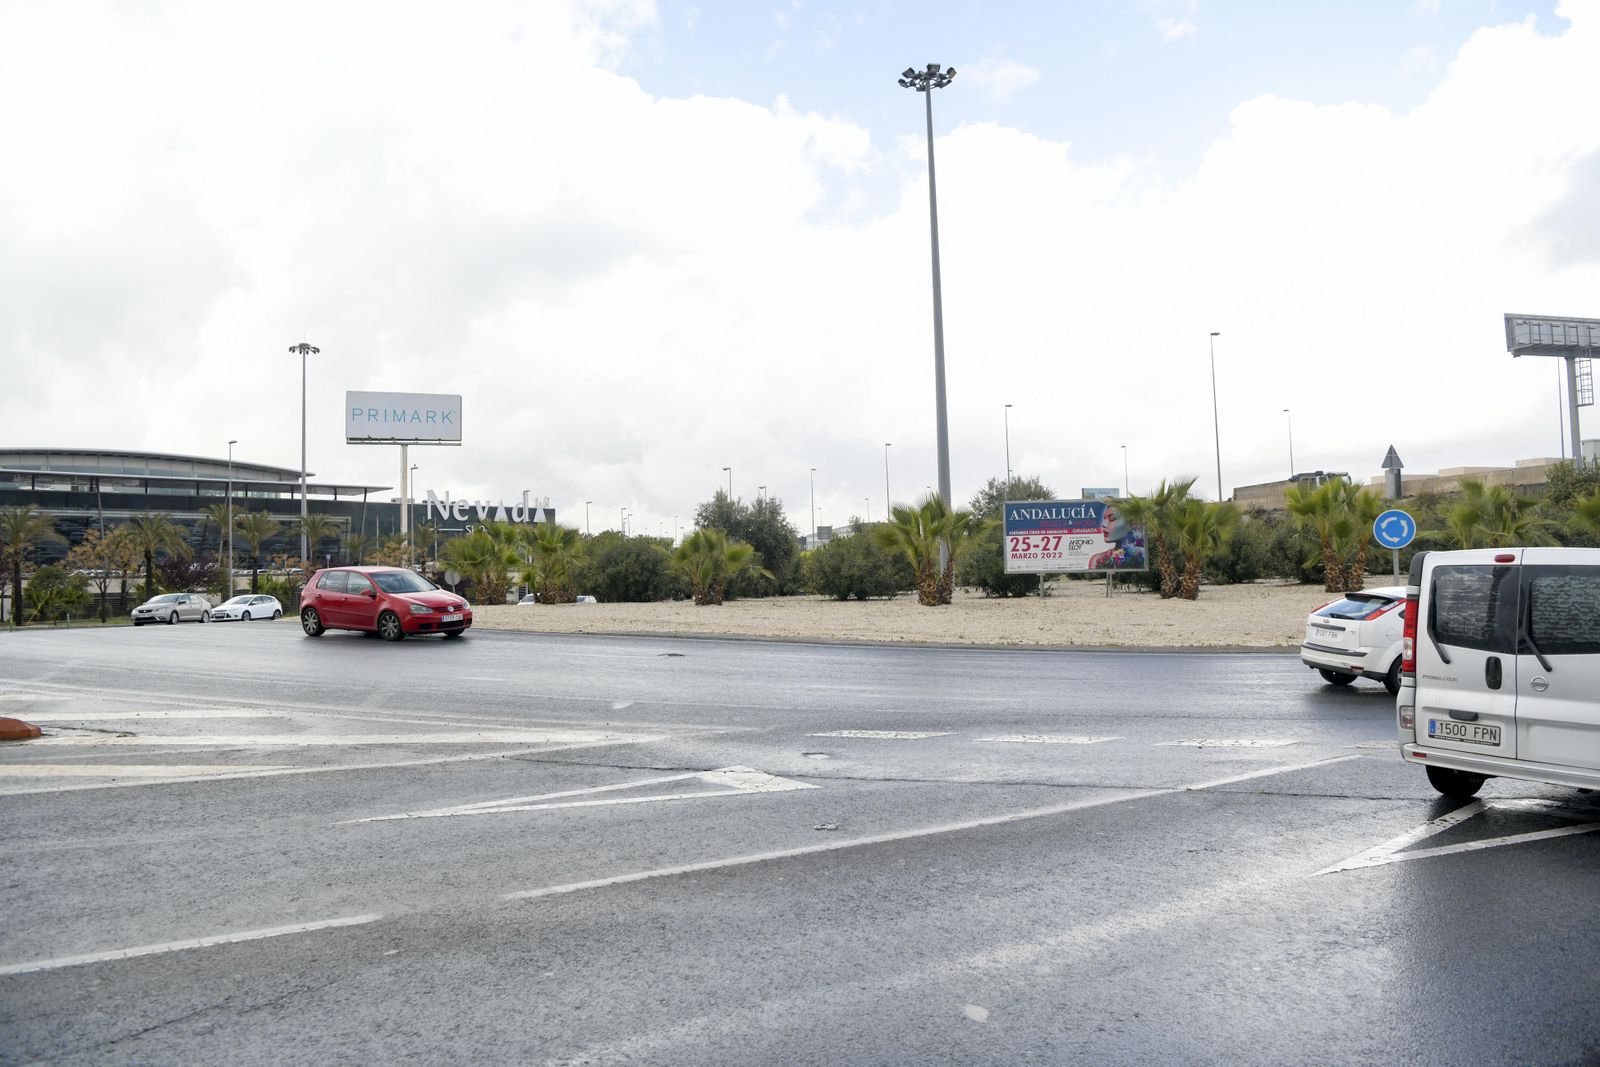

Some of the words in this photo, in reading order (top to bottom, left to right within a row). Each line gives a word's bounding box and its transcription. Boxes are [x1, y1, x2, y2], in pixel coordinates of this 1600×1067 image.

[351, 407, 453, 424] PRIMARK
[1009, 505, 1096, 520] ANDALUCÍA
[1010, 536, 1062, 552] 25-27
[1041, 551, 1062, 559] 2022
[1438, 722, 1467, 737] 1500
[1473, 727, 1497, 741] FPN
